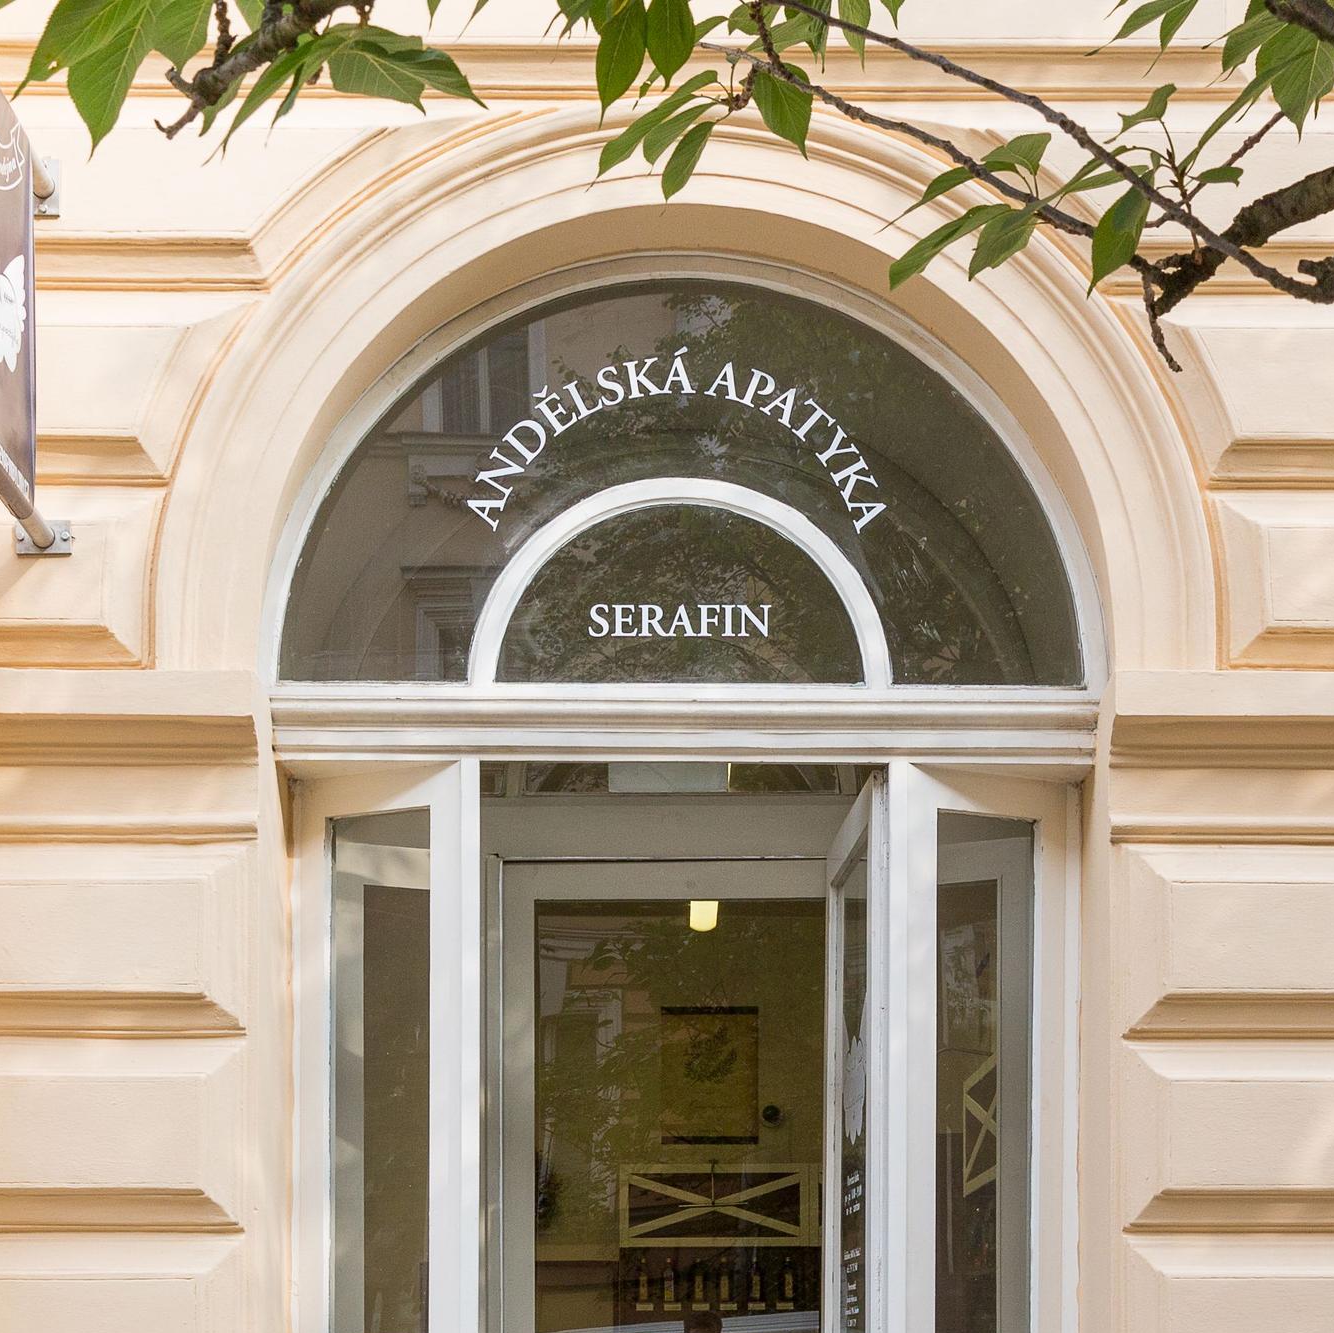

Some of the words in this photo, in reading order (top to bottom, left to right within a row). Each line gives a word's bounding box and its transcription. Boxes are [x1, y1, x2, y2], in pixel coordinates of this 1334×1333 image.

[466, 346, 696, 532] ANDĚLSKÁ
[704, 361, 888, 534] APATYKA
[588, 603, 772, 638] SERAFIN
